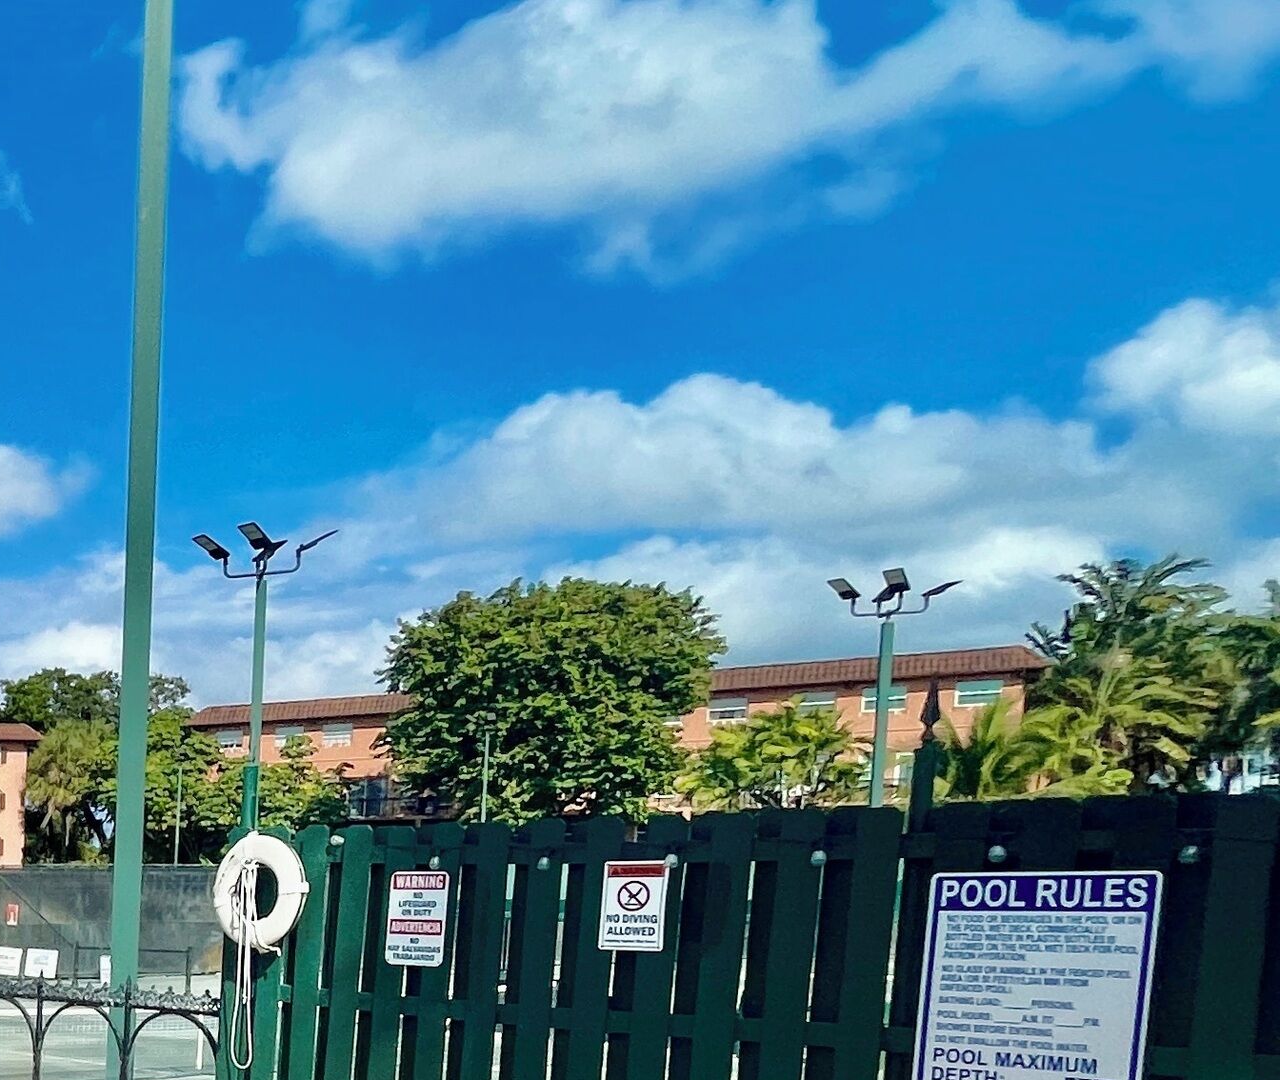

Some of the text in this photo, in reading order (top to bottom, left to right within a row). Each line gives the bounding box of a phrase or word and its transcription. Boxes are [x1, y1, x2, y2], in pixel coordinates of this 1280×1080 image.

[396, 875, 444, 889] WARNING
[940, 877, 1149, 908] POOL RULES
[606, 914, 658, 924] NO DIVING
[607, 927, 655, 936] ALLOWED
[933, 1047, 1098, 1075] POOL MAXIMUM
